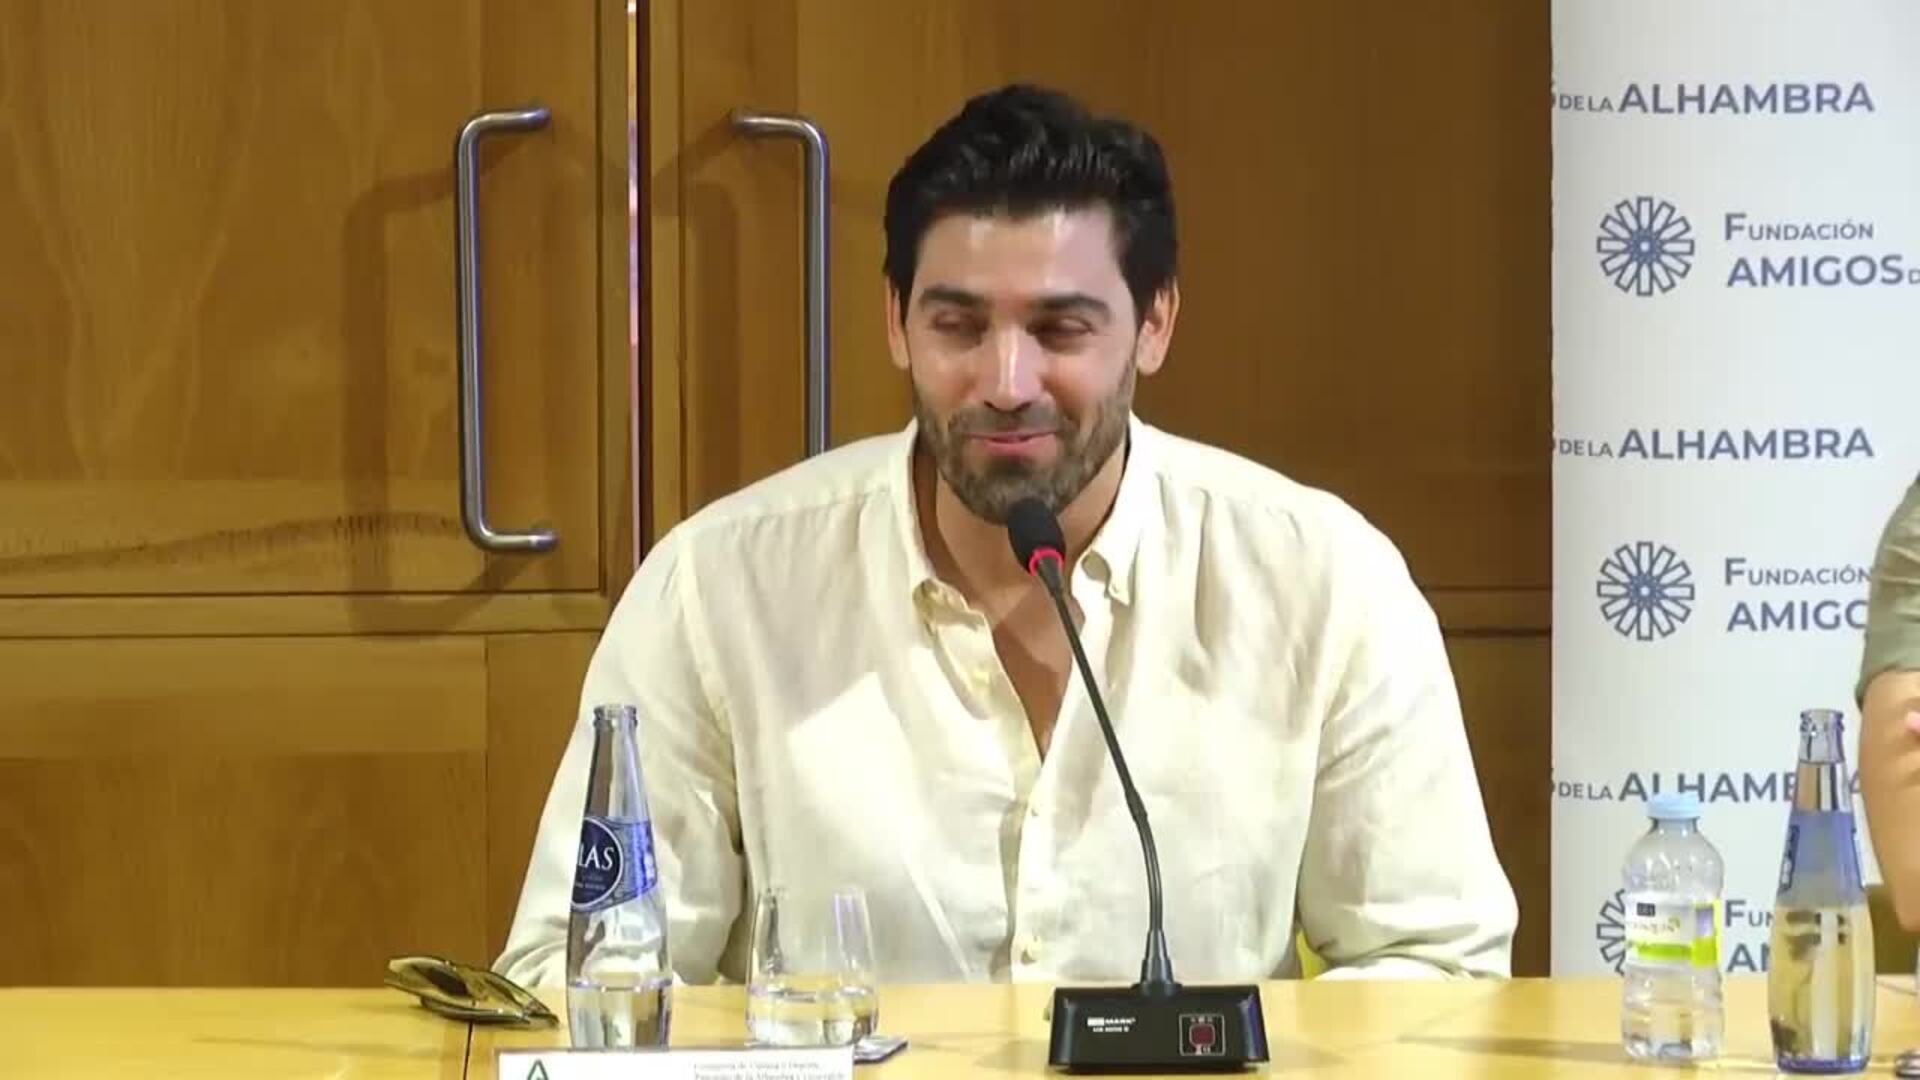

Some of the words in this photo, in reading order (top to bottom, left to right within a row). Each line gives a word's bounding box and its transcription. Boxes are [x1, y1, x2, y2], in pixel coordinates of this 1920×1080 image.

[1559, 94, 1584, 111] DE
[1588, 95, 1614, 112] LA
[1618, 82, 1875, 114] ALHAMBRA
[1724, 212, 1874, 242] FUNDACIÓN
[1727, 253, 1904, 287] AMIGOS
[1559, 438, 1584, 456] DE
[1588, 440, 1614, 458] LA
[1618, 428, 1875, 459] ALHAMBRA
[1727, 600, 1869, 632] AMIGO
[1559, 781, 1584, 799] DE
[1588, 782, 1613, 801] LA
